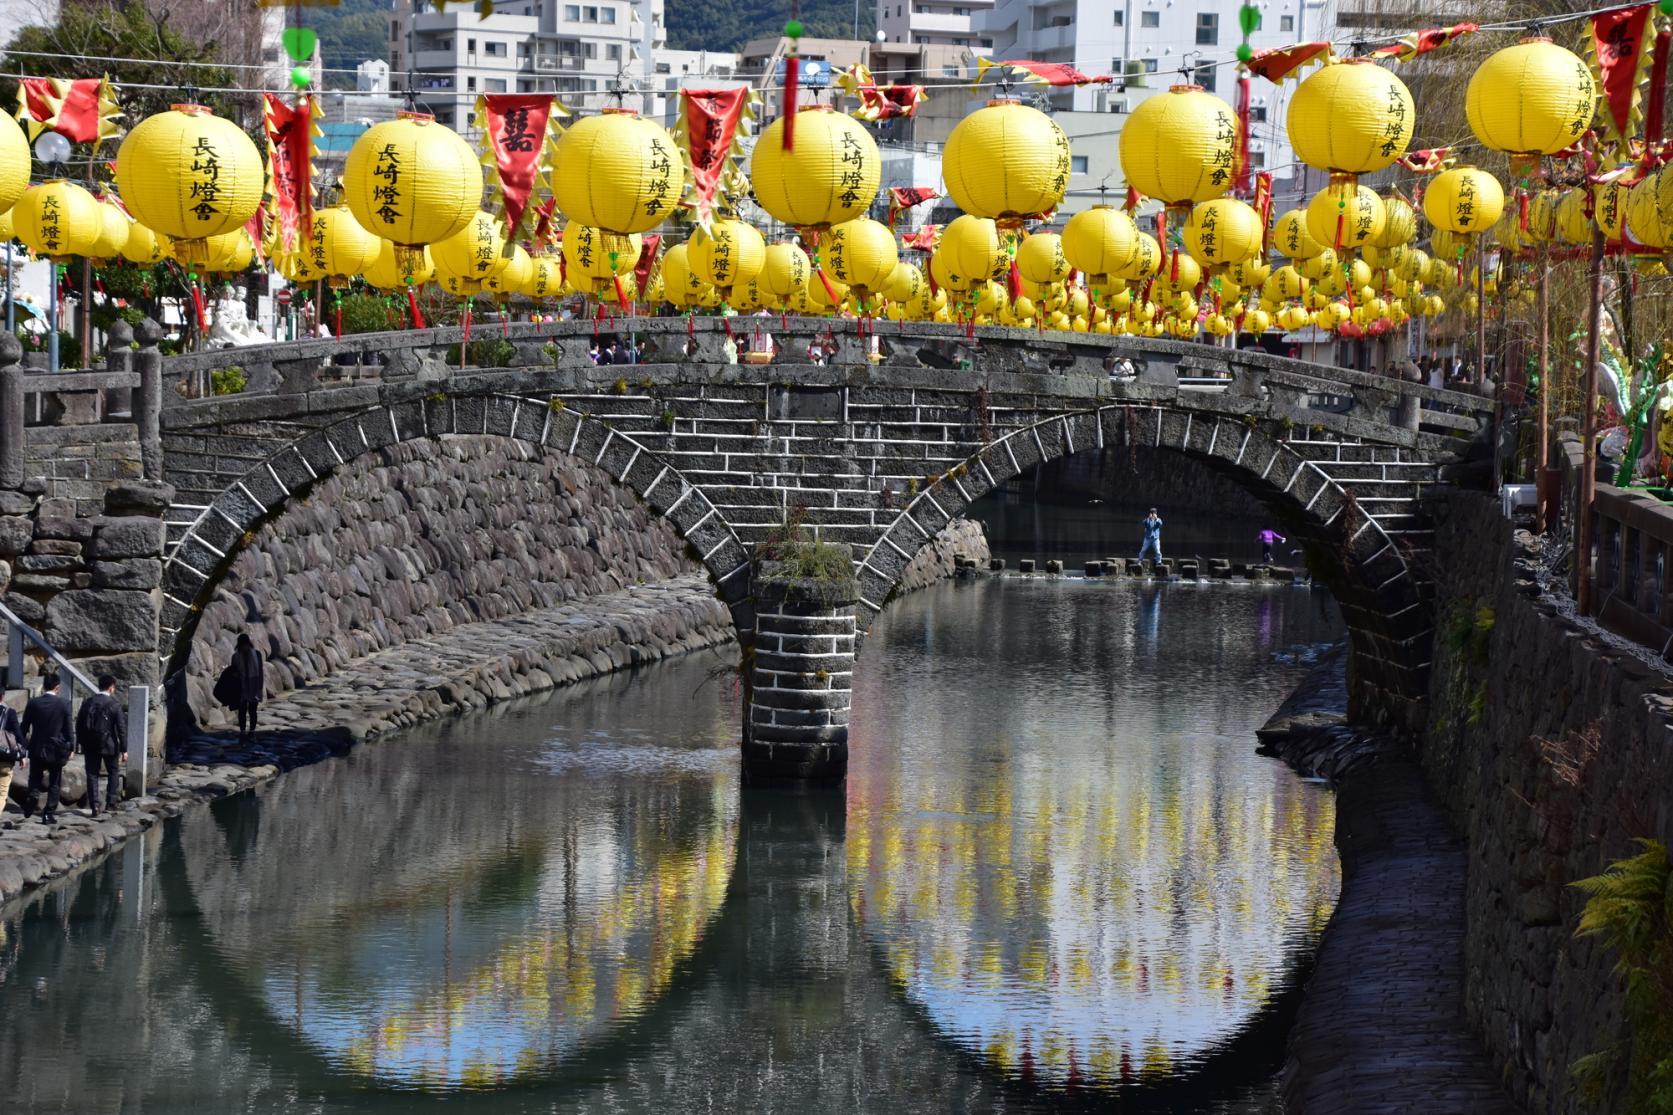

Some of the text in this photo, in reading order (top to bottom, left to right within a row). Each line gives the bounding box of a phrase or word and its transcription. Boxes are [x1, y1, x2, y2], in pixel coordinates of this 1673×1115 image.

[1209, 111, 1235, 186] 長崎燈會
[1380, 84, 1406, 158] 長崎燈會
[189, 137, 221, 220] 長崎燈會
[373, 144, 403, 224] 長崎燈會
[643, 138, 671, 216] 長崎燈會
[838, 131, 865, 209] 長崎燈會
[1455, 175, 1477, 227] 長崎燈會
[41, 195, 62, 250] 長崎燈會
[475, 219, 493, 271] 長崎燈會
[712, 230, 732, 282] 長崎燈會
[1200, 207, 1218, 257] 長崎燈會
